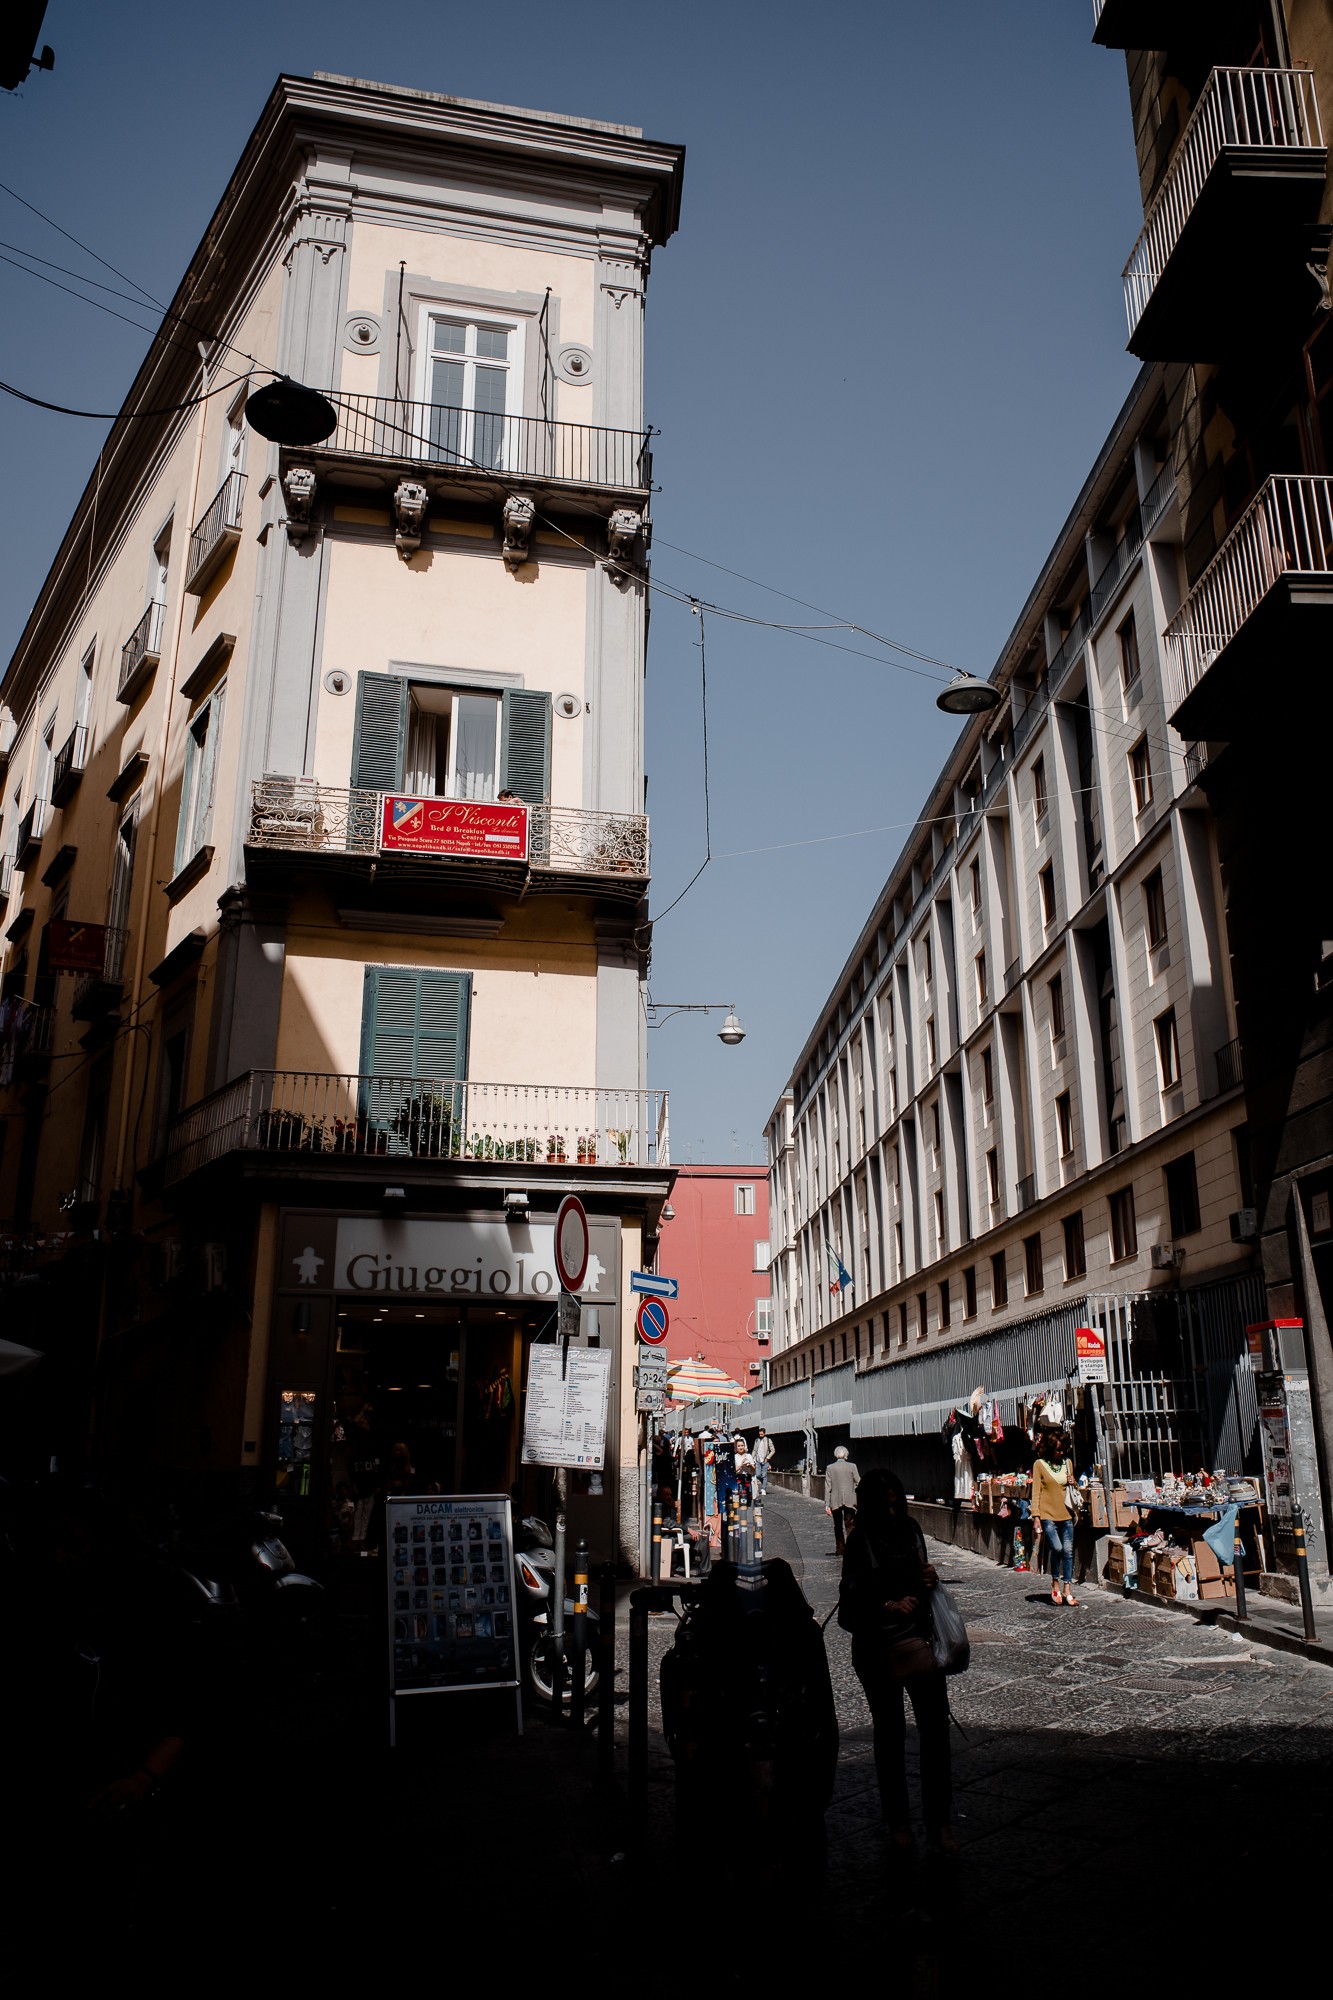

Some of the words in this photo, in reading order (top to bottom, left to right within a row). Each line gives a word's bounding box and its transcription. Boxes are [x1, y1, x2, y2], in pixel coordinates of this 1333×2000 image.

[454, 806, 520, 828] Visconti
[430, 824, 445, 832] Bed
[454, 826, 486, 835] Breakfast
[461, 833, 484, 841] Centro
[567, 1350, 602, 1361] Food
[416, 1503, 452, 1514] DACAM
